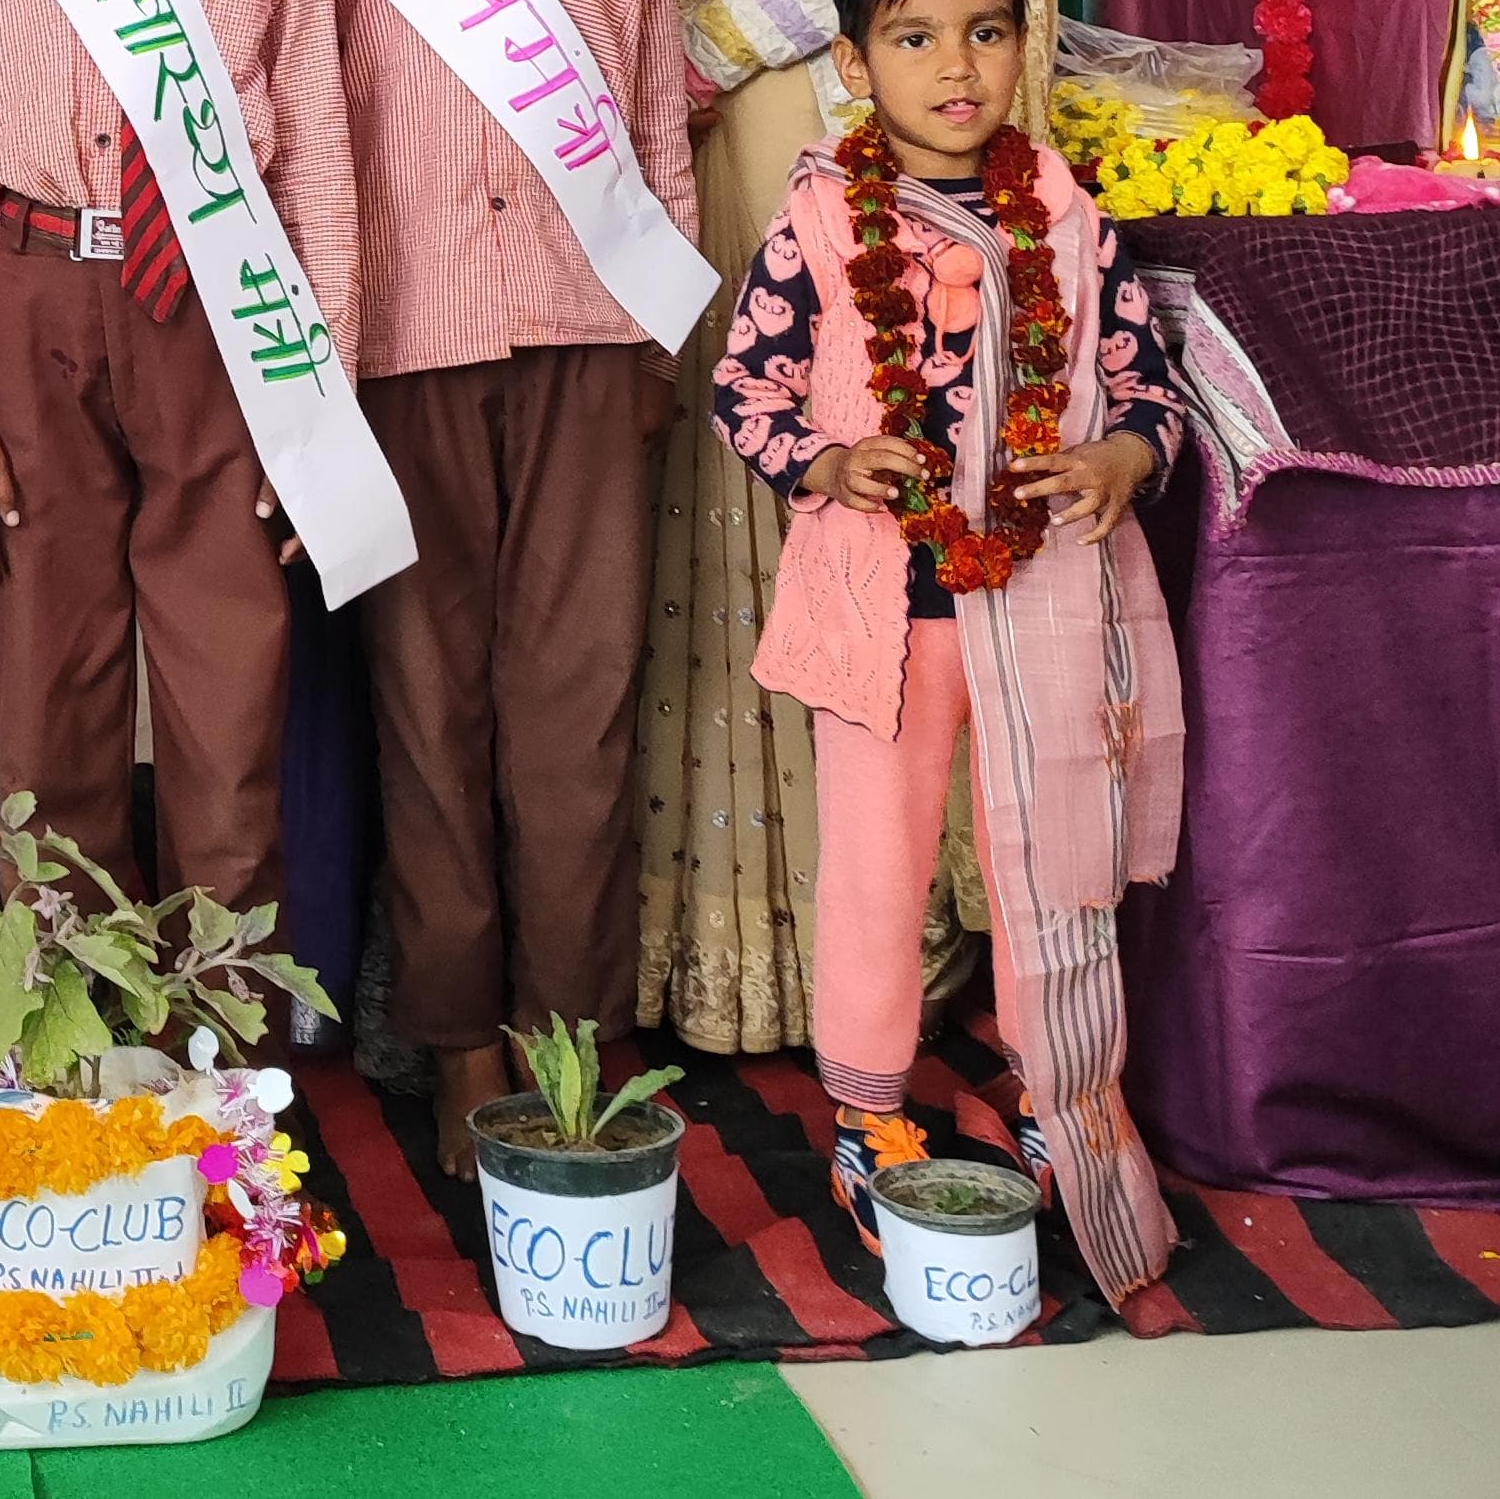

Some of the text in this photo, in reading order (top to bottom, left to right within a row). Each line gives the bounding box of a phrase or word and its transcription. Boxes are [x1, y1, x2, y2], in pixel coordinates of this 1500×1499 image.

[230, 252, 332, 399] मंत्री
[492, 1199, 676, 1289] ECO-CLU
[31, 1267, 123, 1292] NAHILI
[923, 1257, 1037, 1302] ECO-CL
[562, 1295, 637, 1325] NAHILI
[104, 1393, 212, 1427] NAHILI
